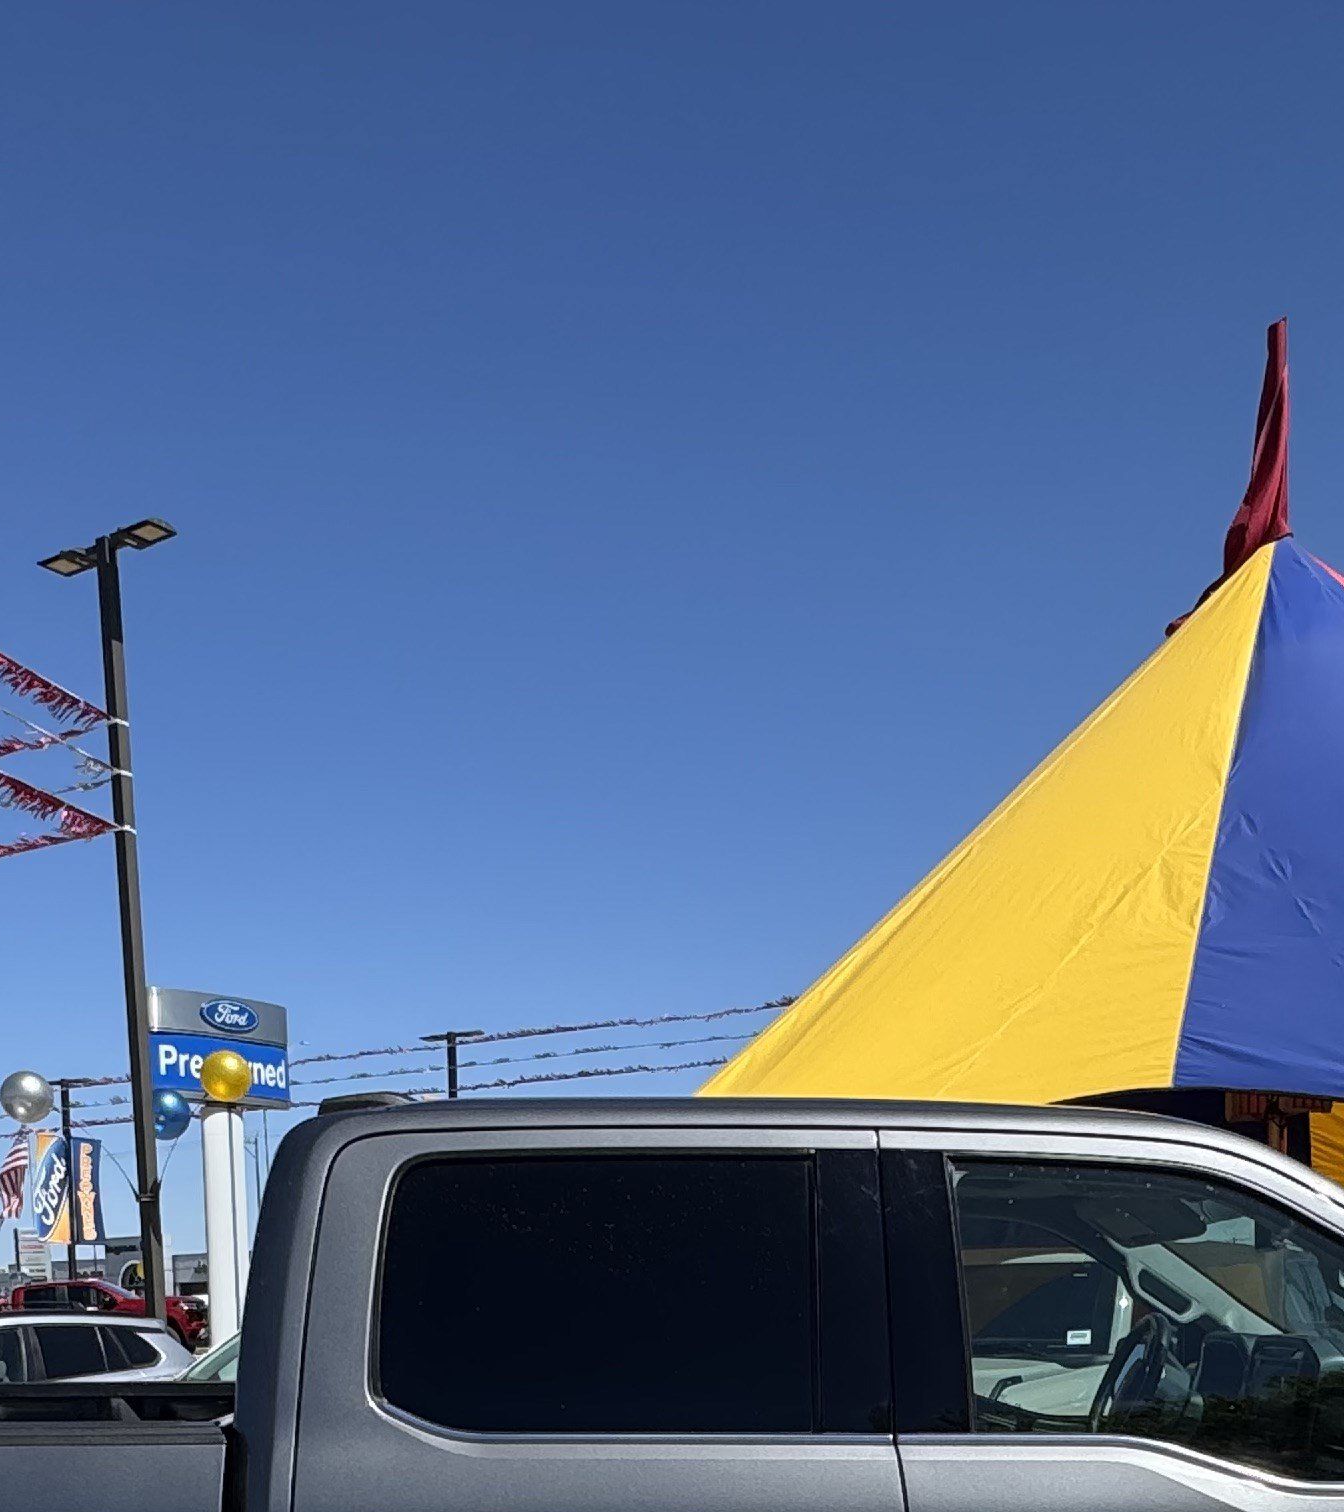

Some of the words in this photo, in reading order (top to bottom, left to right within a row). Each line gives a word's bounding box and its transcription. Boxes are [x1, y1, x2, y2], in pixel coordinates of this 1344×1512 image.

[214, 1003, 249, 1026] Ford
[158, 1044, 286, 1089] Prened
[33, 1153, 67, 1226] Ford
